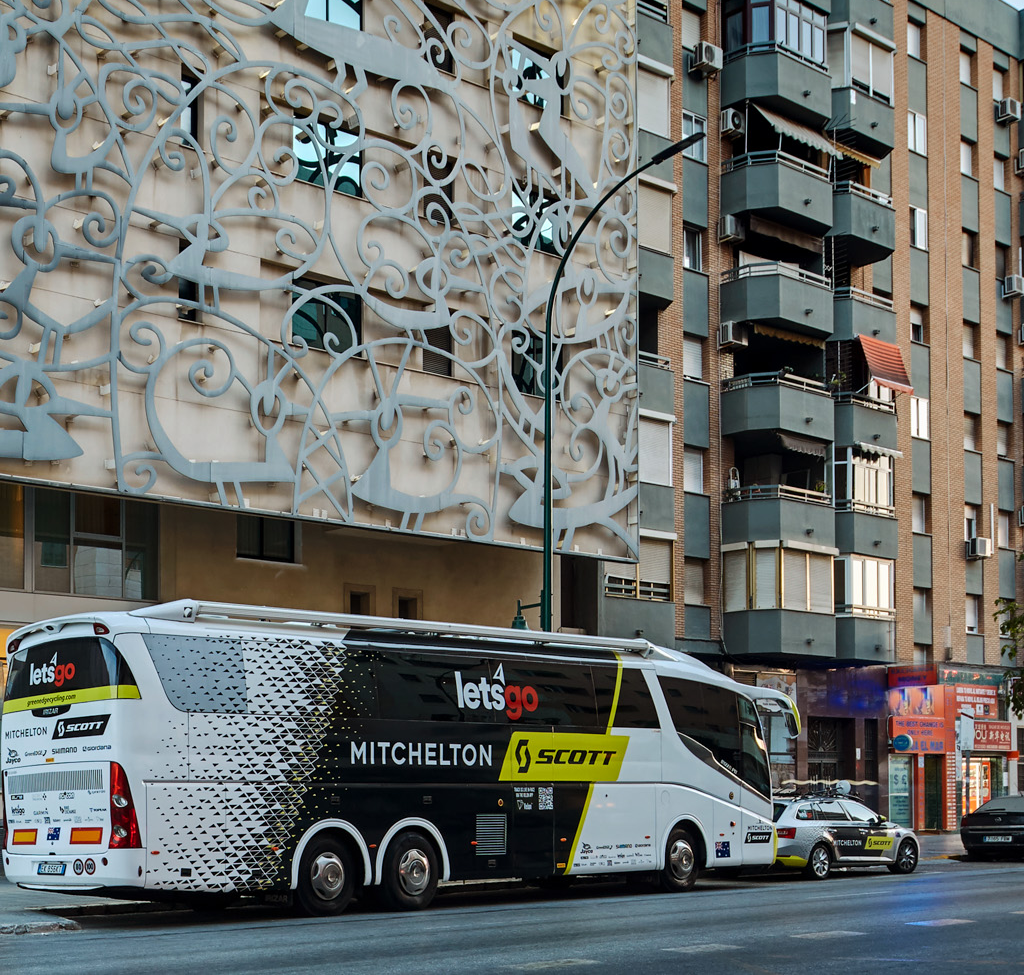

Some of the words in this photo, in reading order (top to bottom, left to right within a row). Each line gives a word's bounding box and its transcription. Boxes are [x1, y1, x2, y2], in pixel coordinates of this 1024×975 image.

[4, 726, 48, 740] MITCHELTON
[65, 721, 104, 732] SCOTT
[974, 730, 987, 740] OU
[51, 746, 78, 755] SHIMANO
[350, 740, 493, 767] MITCHELTON
[534, 748, 617, 766] SCOTT
